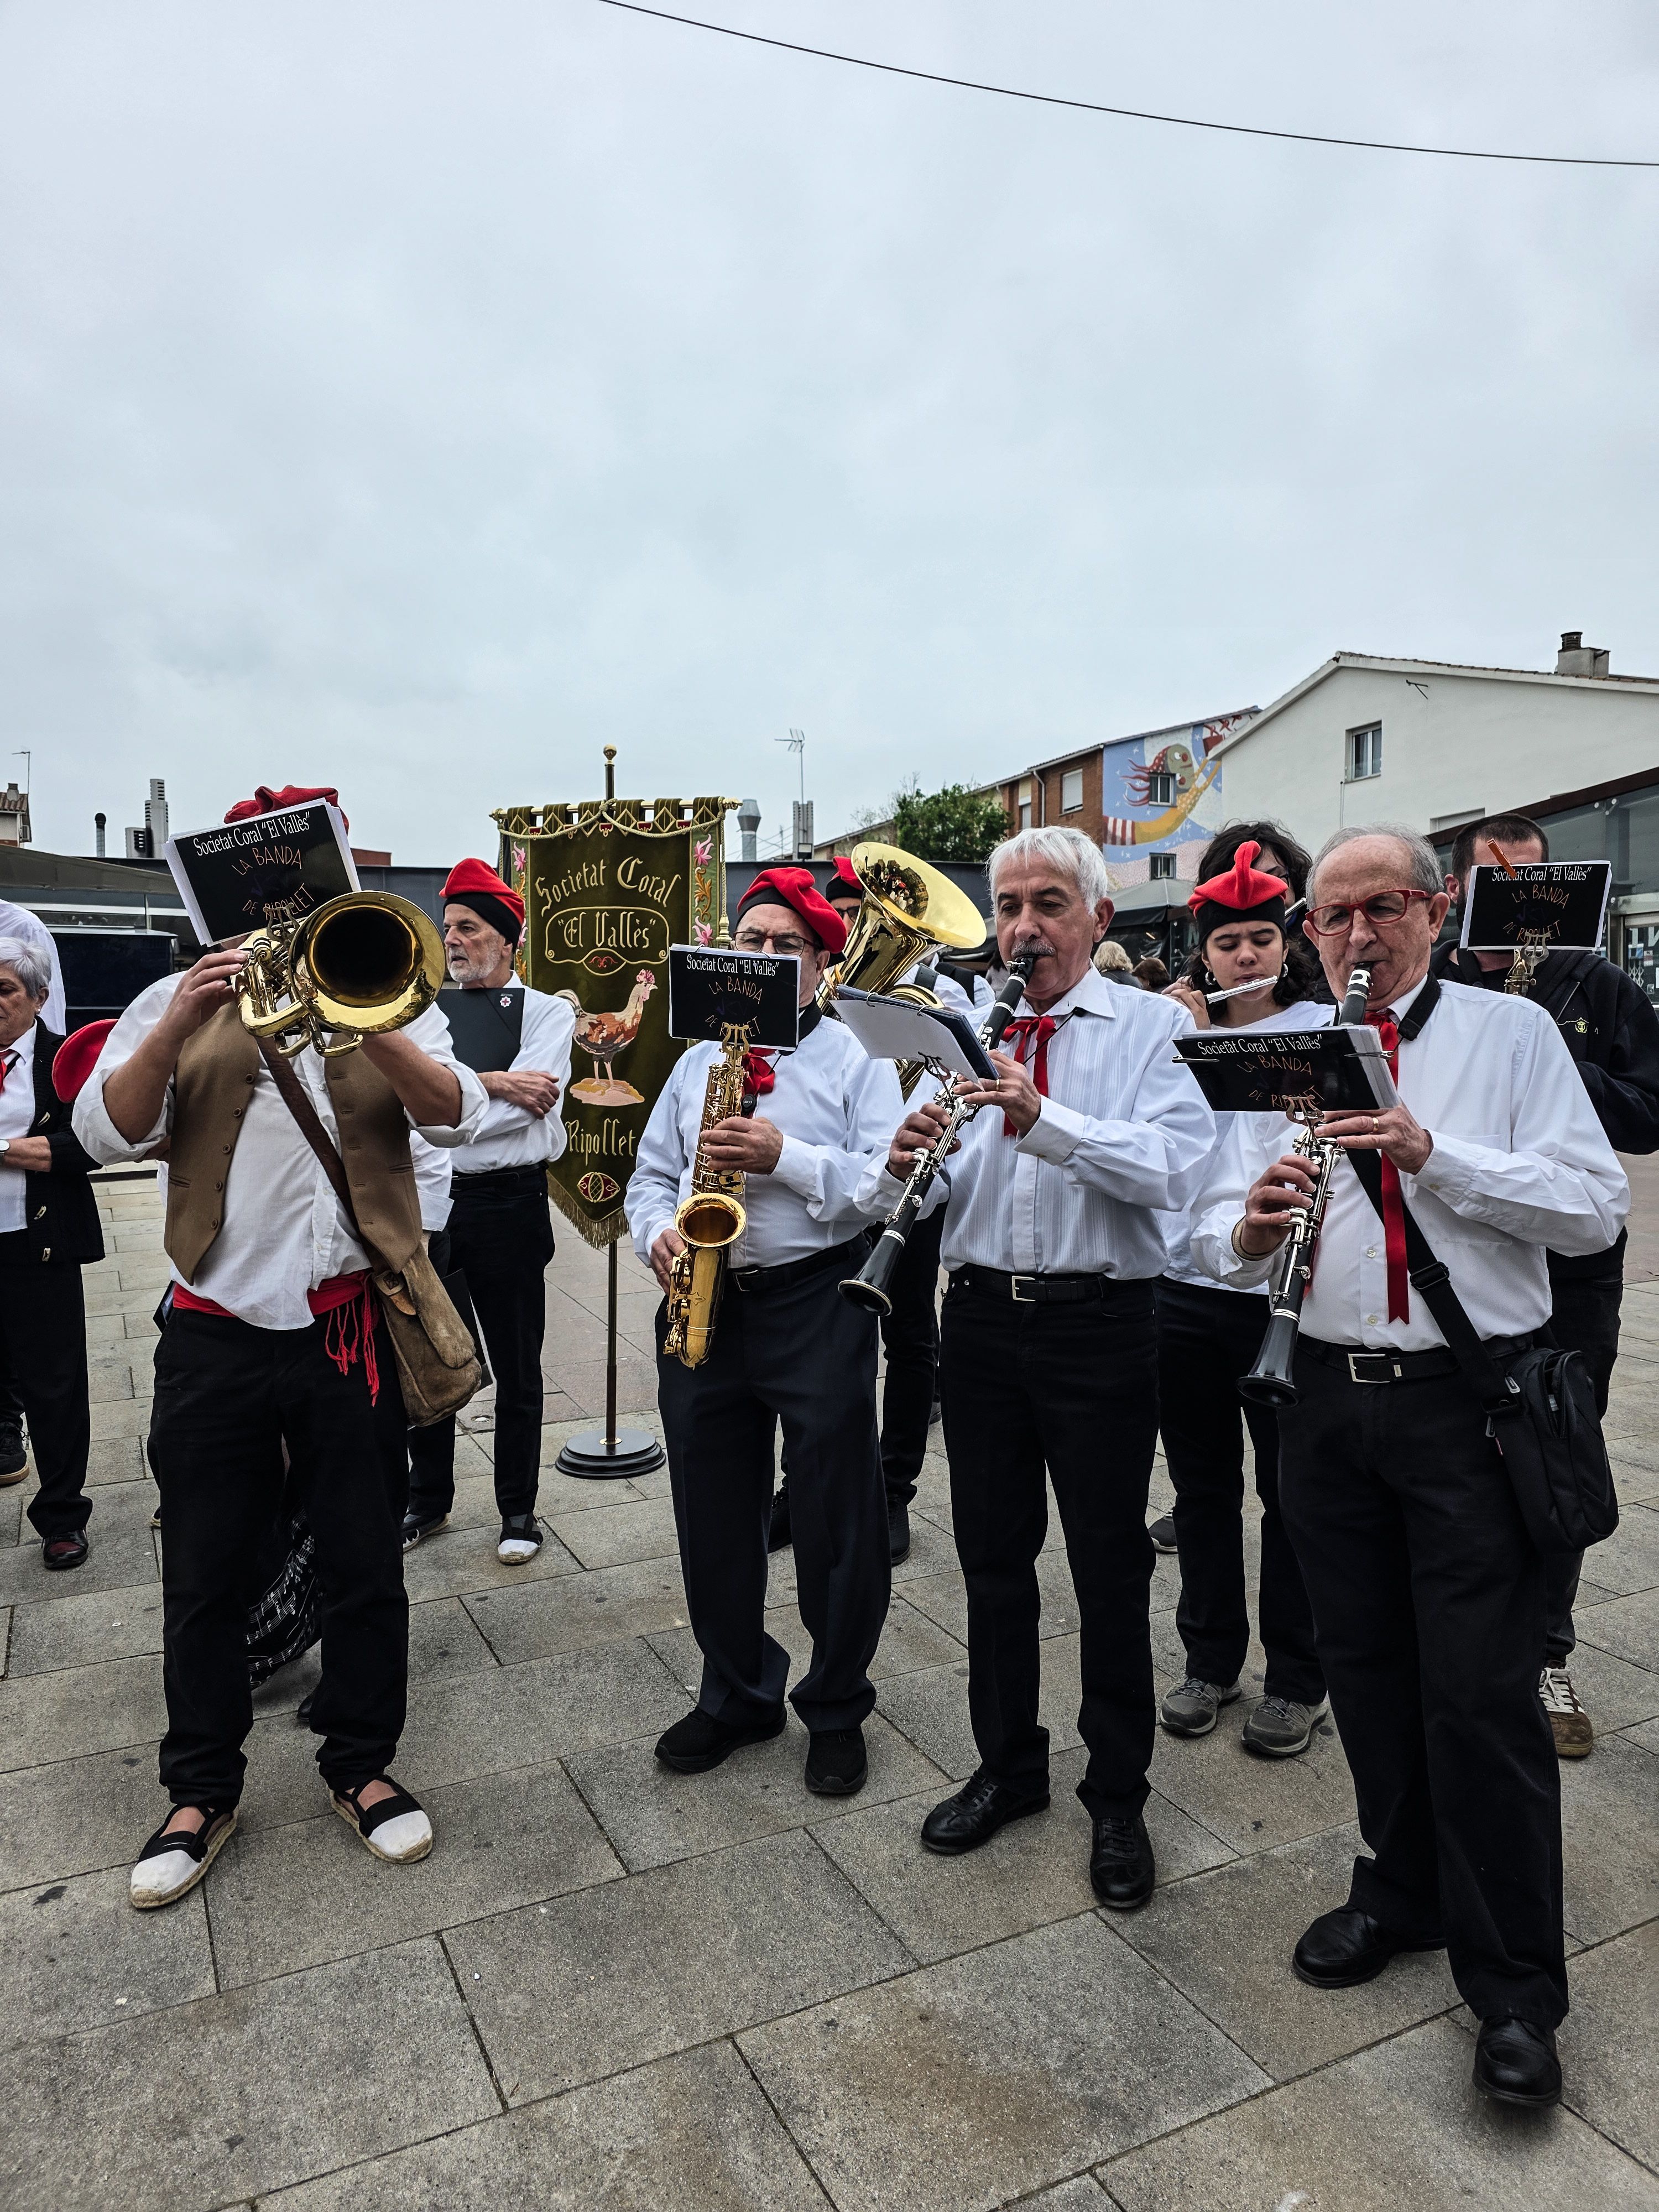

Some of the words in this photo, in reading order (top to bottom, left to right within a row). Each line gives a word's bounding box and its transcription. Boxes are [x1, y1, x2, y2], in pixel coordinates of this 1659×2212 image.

[194, 832, 235, 856] Societat
[233, 823, 263, 847] Coral
[231, 859, 253, 875] LA
[252, 845, 302, 870] BANDA
[1525, 867, 1547, 881] Coral
[535, 859, 607, 917] Societat
[617, 856, 681, 907] Coral
[1511, 890, 1527, 903] LA
[1532, 884, 1570, 909] BANDA
[242, 899, 258, 915] DE
[1503, 921, 1517, 935] DE
[687, 953, 716, 972] Societat
[717, 957, 738, 973] Coral
[708, 981, 723, 995] LA
[727, 975, 763, 1005] BANDA
[705, 1014, 718, 1028] DE
[1197, 1039, 1237, 1055] Societat
[1238, 1038, 1269, 1053] Coral
[1237, 1061, 1258, 1073] LA
[1257, 1055, 1312, 1076] BANDA
[1248, 1089, 1265, 1102] DE
[565, 1118, 637, 1166] Ripollet
